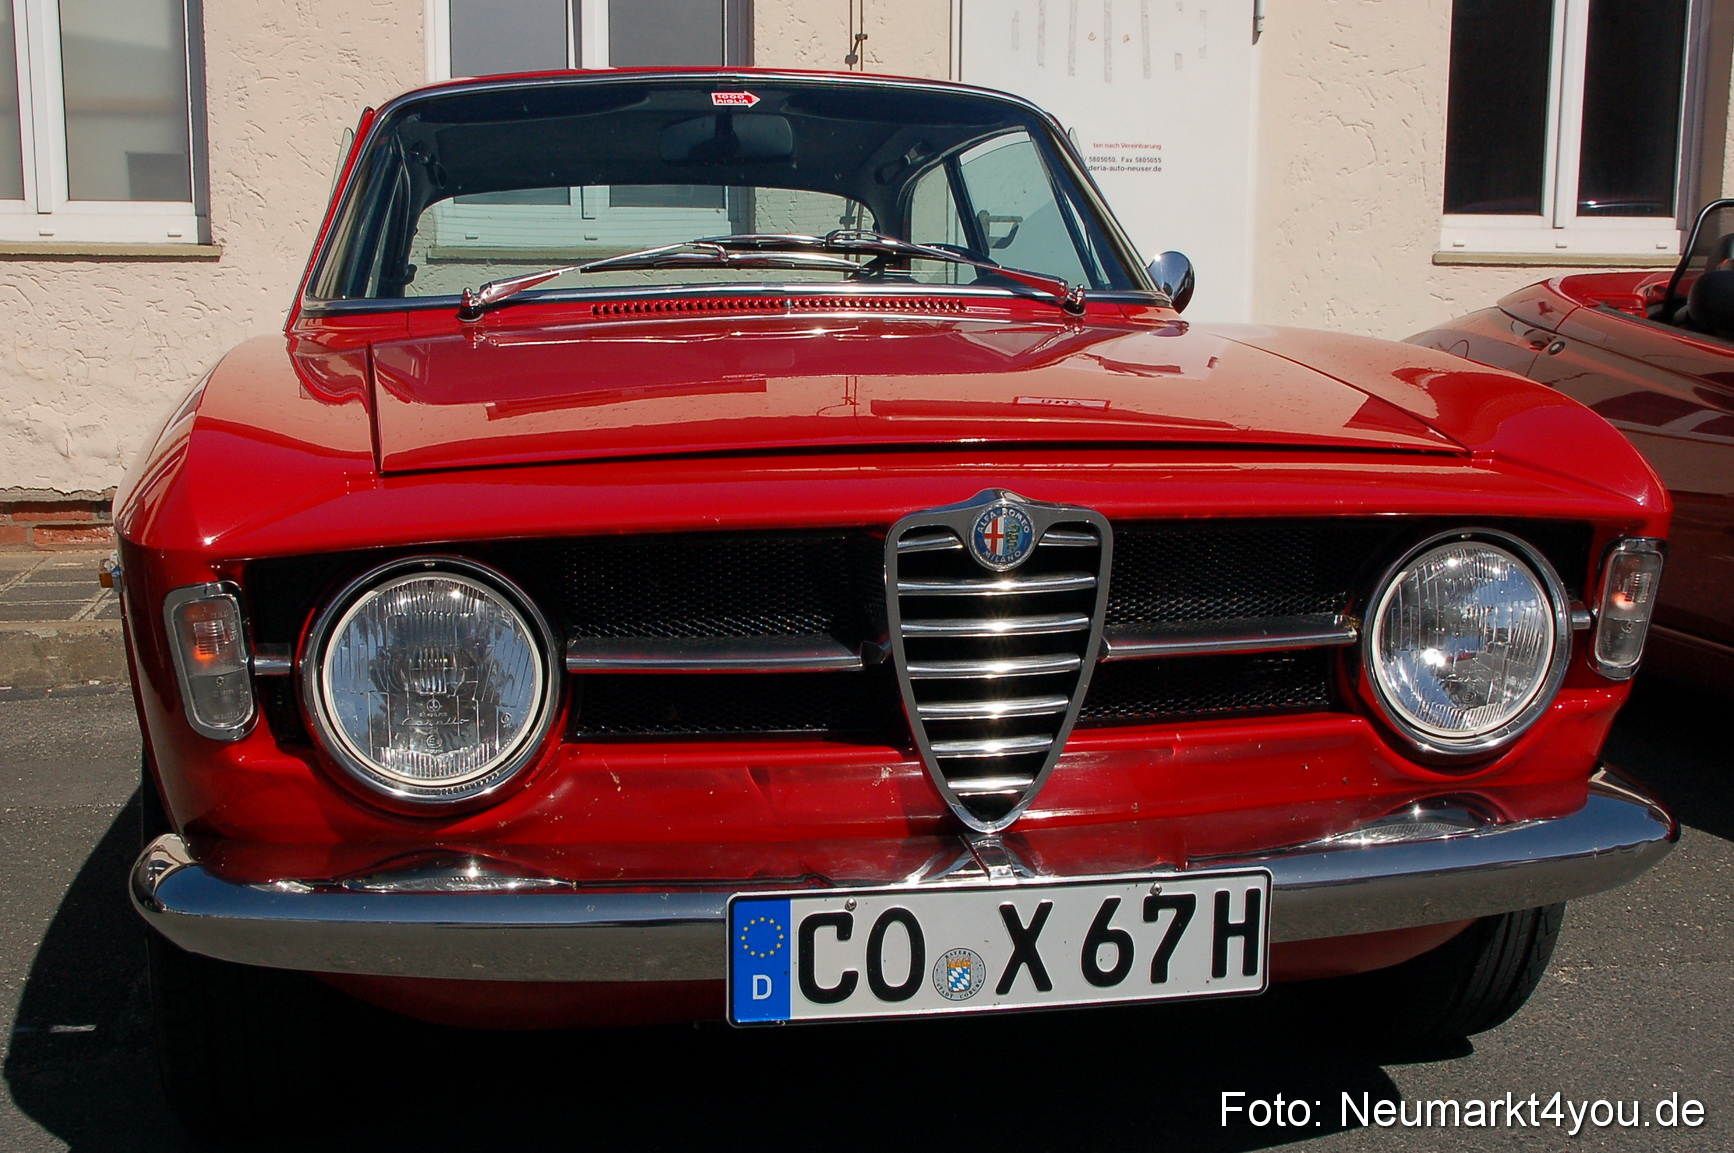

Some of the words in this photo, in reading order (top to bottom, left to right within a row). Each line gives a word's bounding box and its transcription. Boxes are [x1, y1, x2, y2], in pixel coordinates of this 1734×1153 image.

[1120, 143, 1162, 151] Vereinbarung
[977, 511, 998, 534] ALFA
[1002, 508, 1030, 534] ROMEO
[982, 550, 1022, 563] MILANO
[797, 906, 926, 1005] CO
[995, 901, 1054, 996] X
[945, 950, 972, 959] BAYERN
[752, 974, 772, 1000] D
[936, 983, 954, 999] STADT
[959, 979, 983, 999] COBURG
